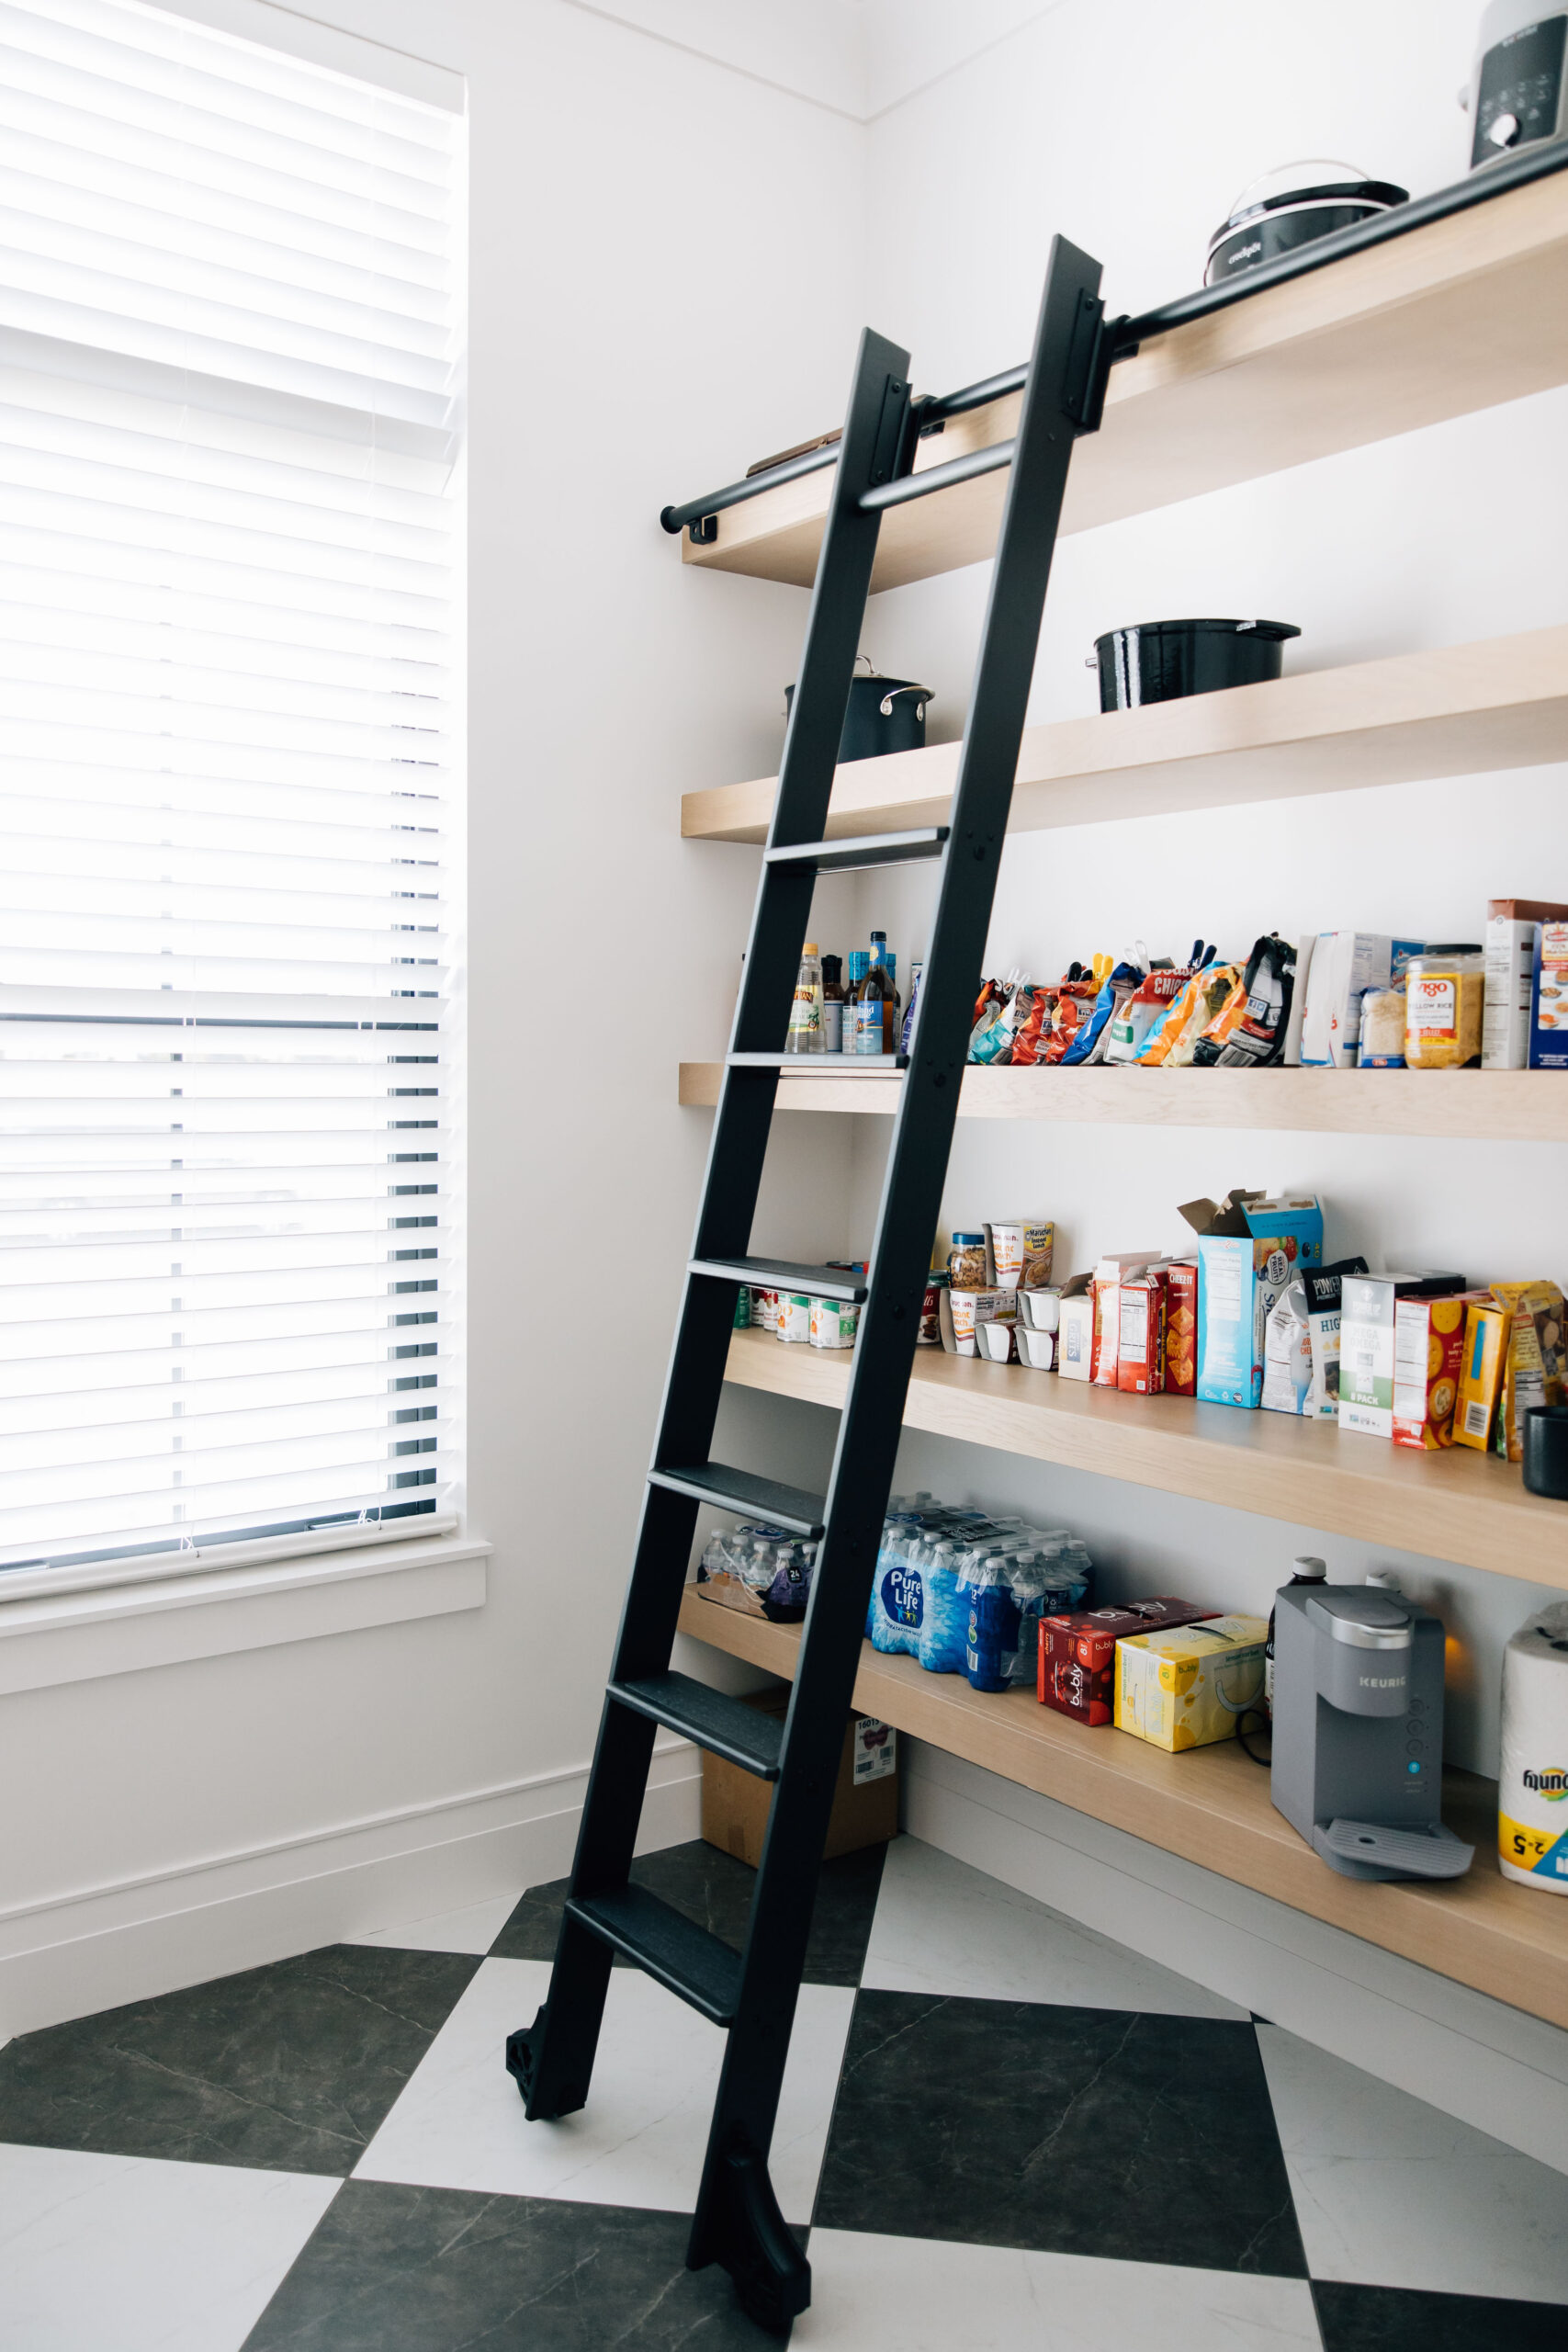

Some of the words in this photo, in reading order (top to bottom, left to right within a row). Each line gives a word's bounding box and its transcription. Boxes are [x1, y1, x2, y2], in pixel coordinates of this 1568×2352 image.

[1416, 982, 1448, 997] vigo
[1030, 1227, 1052, 1237] Maruchan
[1276, 1255, 1285, 1278] REAL
[1321, 1317, 1341, 1332] HIG
[1068, 1323, 1077, 1357] GRITS
[1358, 1394, 1379, 1406] PACK
[790, 1570, 800, 1578] 24
[891, 1570, 921, 1595] Pure
[895, 1588, 918, 1610] Life
[1095, 1641, 1114, 1652] bubly
[1069, 1663, 1083, 1706] bubly
[1359, 1677, 1406, 1689] KEURIG
[1513, 1834, 1527, 1856] 5
[1535, 1840, 1544, 1855] 2
